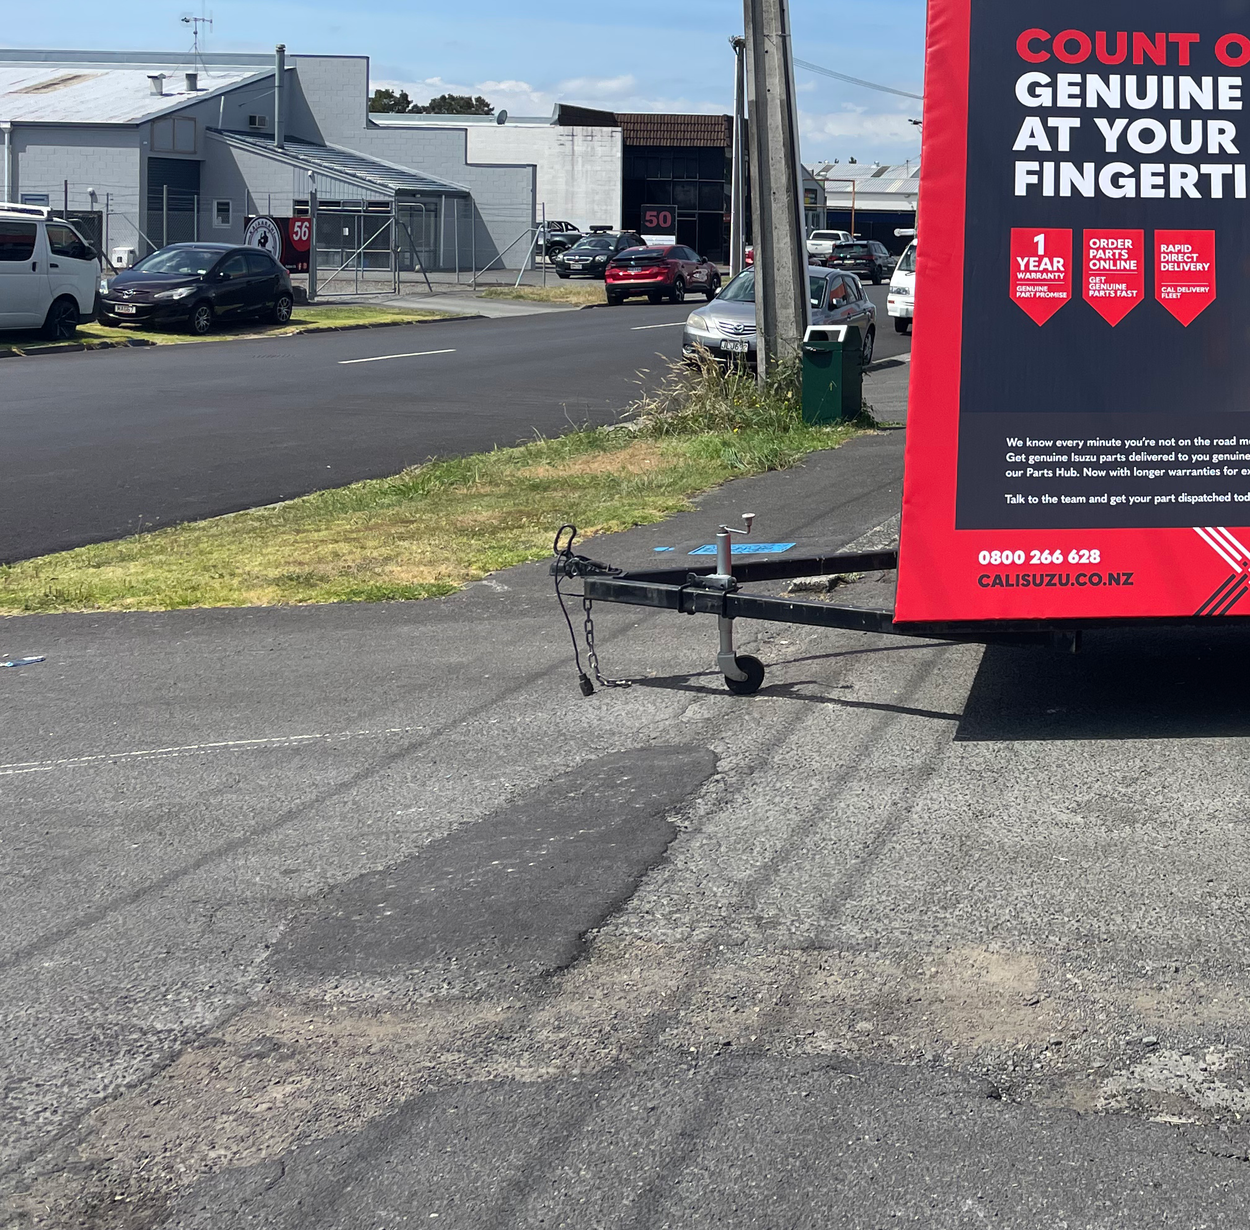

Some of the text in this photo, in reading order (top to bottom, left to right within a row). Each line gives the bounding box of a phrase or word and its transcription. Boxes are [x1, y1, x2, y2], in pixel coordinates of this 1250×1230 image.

[1016, 28, 1200, 66] COUNT
[1015, 72, 1242, 110] GENUINE
[1012, 116, 1239, 154] AT YOUR
[644, 211, 672, 228] 50
[293, 222, 309, 241] 56
[1033, 233, 1045, 256] 1
[1089, 238, 1133, 249] ORDER
[1161, 244, 1192, 252] RAPID
[1089, 250, 1128, 259] PARTS
[1161, 254, 1198, 262] DIRECT
[1016, 257, 1064, 271] YEAR
[1089, 260, 1137, 270] ONLINE
[1161, 262, 1210, 271] DELIVERY
[1016, 272, 1065, 280] WARRANTY
[1006, 437, 1023, 447] We
[1026, 437, 1053, 447] know
[1055, 439, 1084, 449] every
[1086, 437, 1122, 447] minute
[1124, 437, 1156, 449] you’re
[1158, 438, 1175, 447] not
[1178, 439, 1191, 447] on
[1193, 436, 1211, 446] the
[1213, 436, 1237, 446] road
[1005, 452, 1026, 463] Get
[1028, 452, 1068, 465] genuine
[1071, 452, 1096, 462] Isuzu
[1099, 453, 1126, 464] parts
[1128, 451, 1175, 462] delivered
[1177, 452, 1188, 462] to
[1191, 453, 1209, 464] you
[1005, 470, 1023, 478] our
[1026, 467, 1053, 478] Parts
[1055, 467, 1080, 477] Hub.
[1083, 467, 1106, 477] Now
[1108, 466, 1130, 477] with
[1133, 466, 1165, 479] longer
[1167, 466, 1220, 477] warranties
[1222, 465, 1238, 476] for
[1004, 493, 1025, 504] Talk
[1027, 495, 1038, 504] to
[1041, 493, 1058, 504] the
[1060, 494, 1086, 504] team
[1088, 493, 1107, 504] and
[1109, 494, 1126, 506] get
[1128, 495, 1151, 506] your
[1154, 494, 1175, 505] part
[1177, 492, 1231, 505] dispatched
[978, 549, 1100, 564] 0800 266 628
[978, 572, 1134, 588] CALISUZU.CO.NZ
